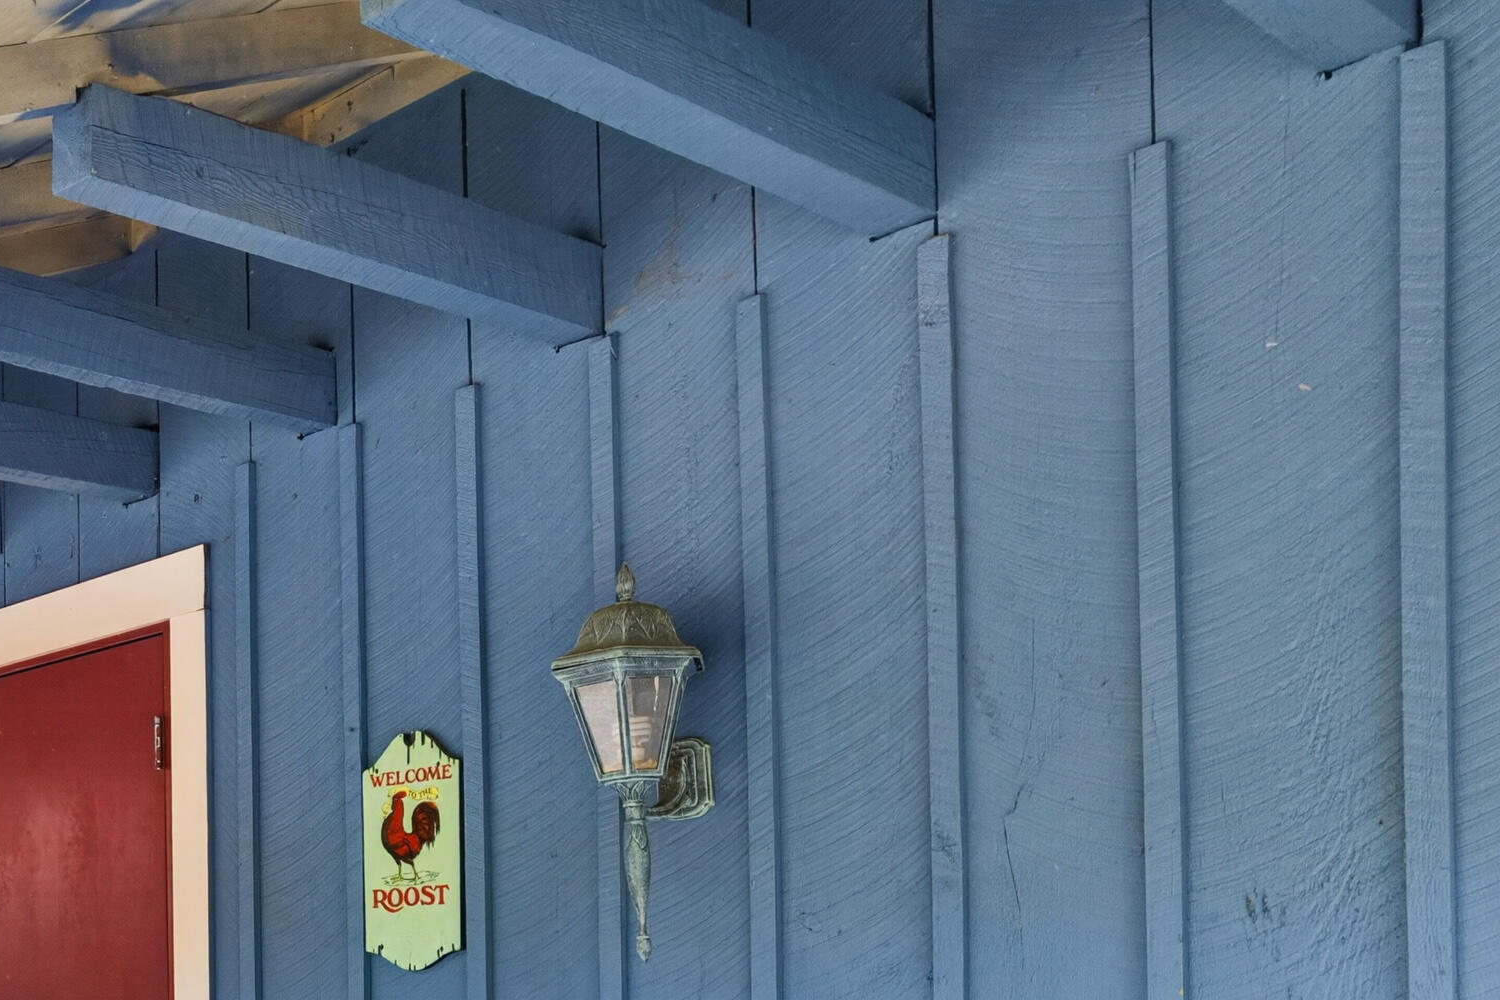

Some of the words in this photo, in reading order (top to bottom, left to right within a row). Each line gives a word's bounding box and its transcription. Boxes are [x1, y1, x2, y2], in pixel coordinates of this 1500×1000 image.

[370, 764, 452, 787] WELCOME
[408, 790, 417, 799] TO
[418, 787, 433, 798] THE
[372, 884, 450, 913] ROOST
